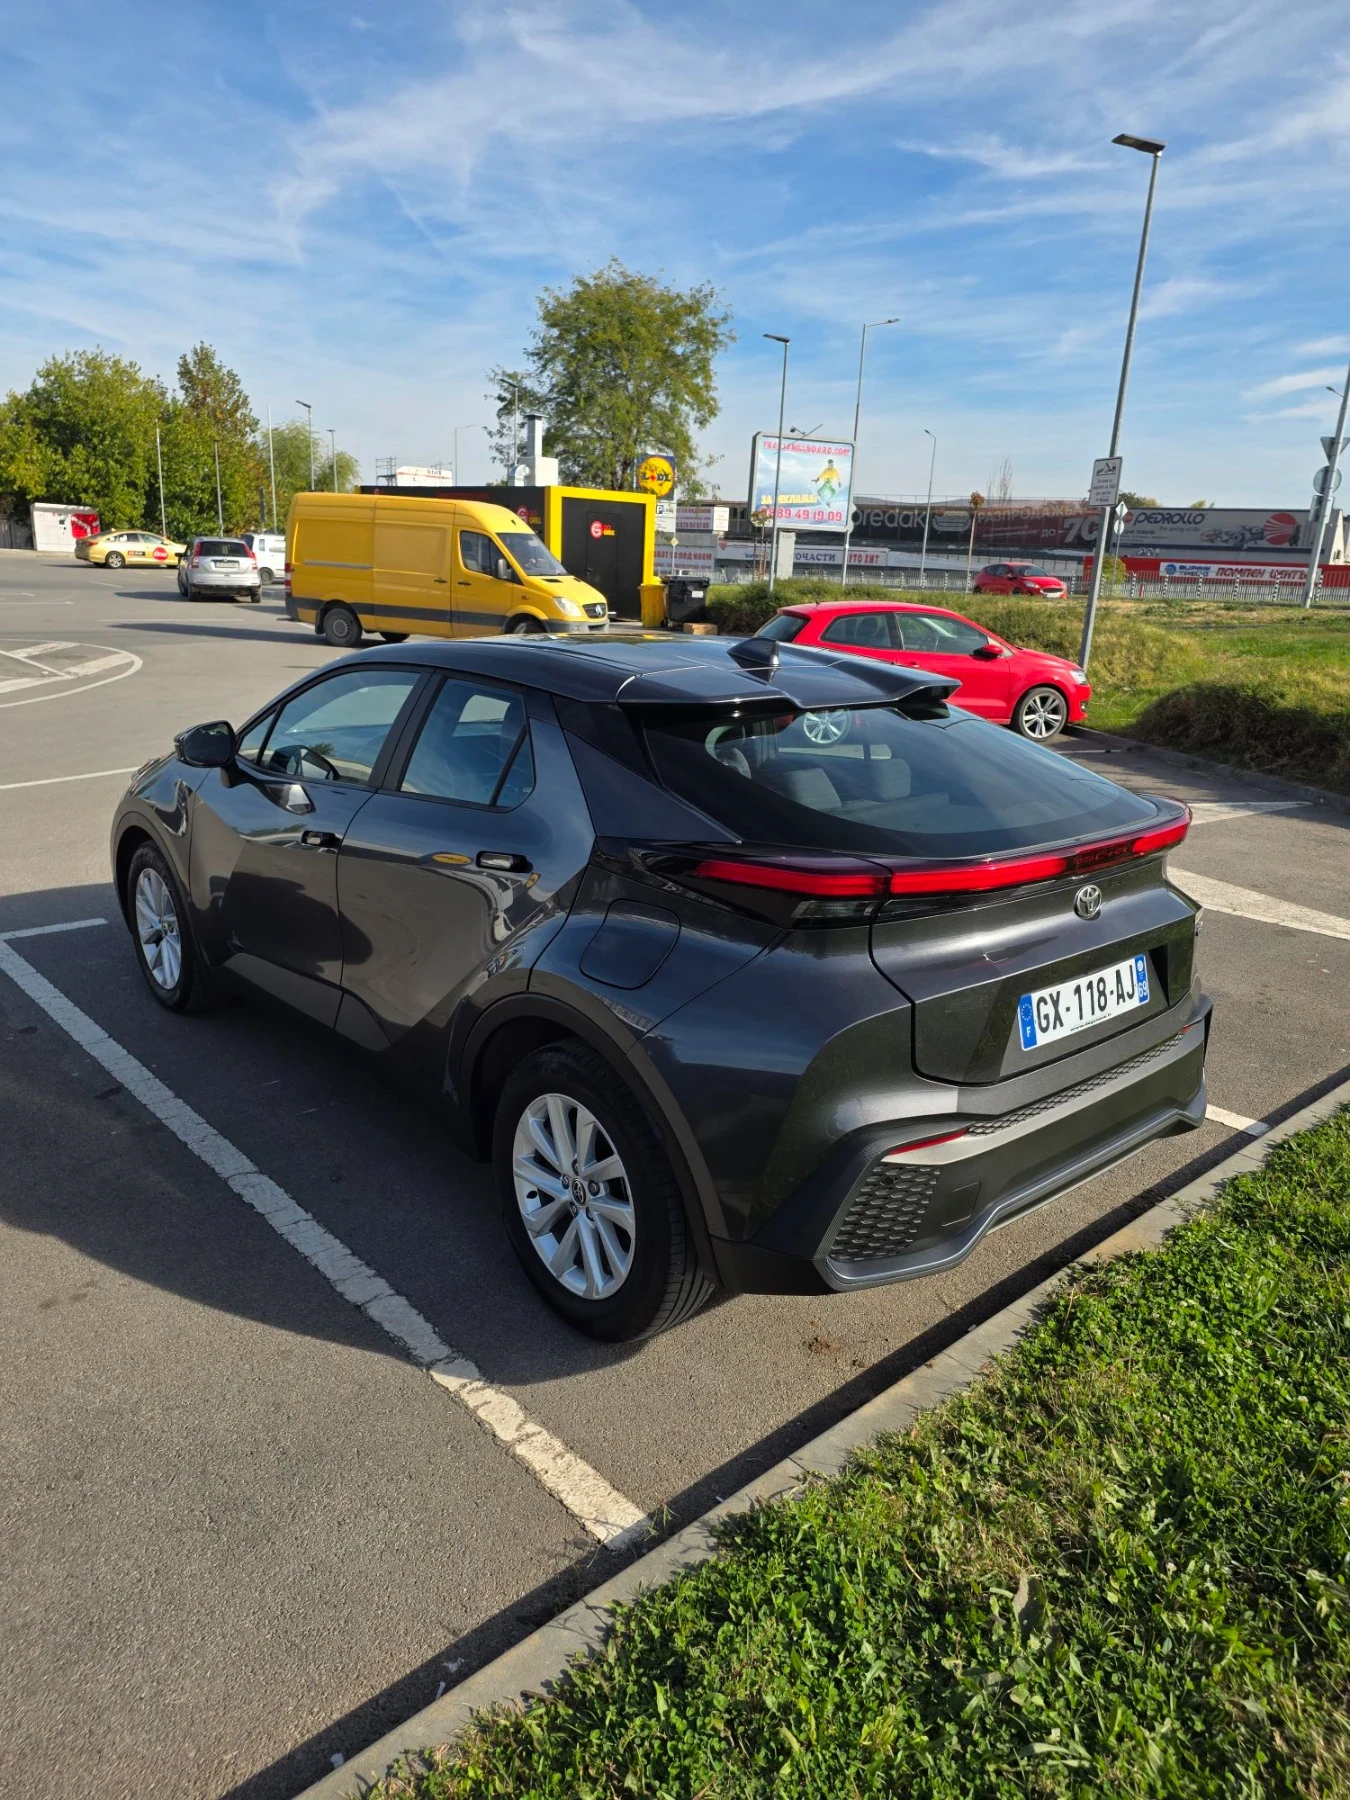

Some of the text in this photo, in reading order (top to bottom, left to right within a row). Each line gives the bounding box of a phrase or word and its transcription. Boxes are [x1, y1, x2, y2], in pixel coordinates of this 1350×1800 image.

[795, 509, 810, 519] 49
[827, 511, 843, 522] 09
[1133, 512, 1205, 526] PEDROLLO
[794, 553, 836, 562] ОЧАСТИ
[1216, 566, 1307, 580] ПОМПЕН ЦЕНТЪ
[1138, 980, 1148, 998] 69
[1036, 964, 1135, 1034] GX-118-AJ
[1026, 1026, 1032, 1038] F
